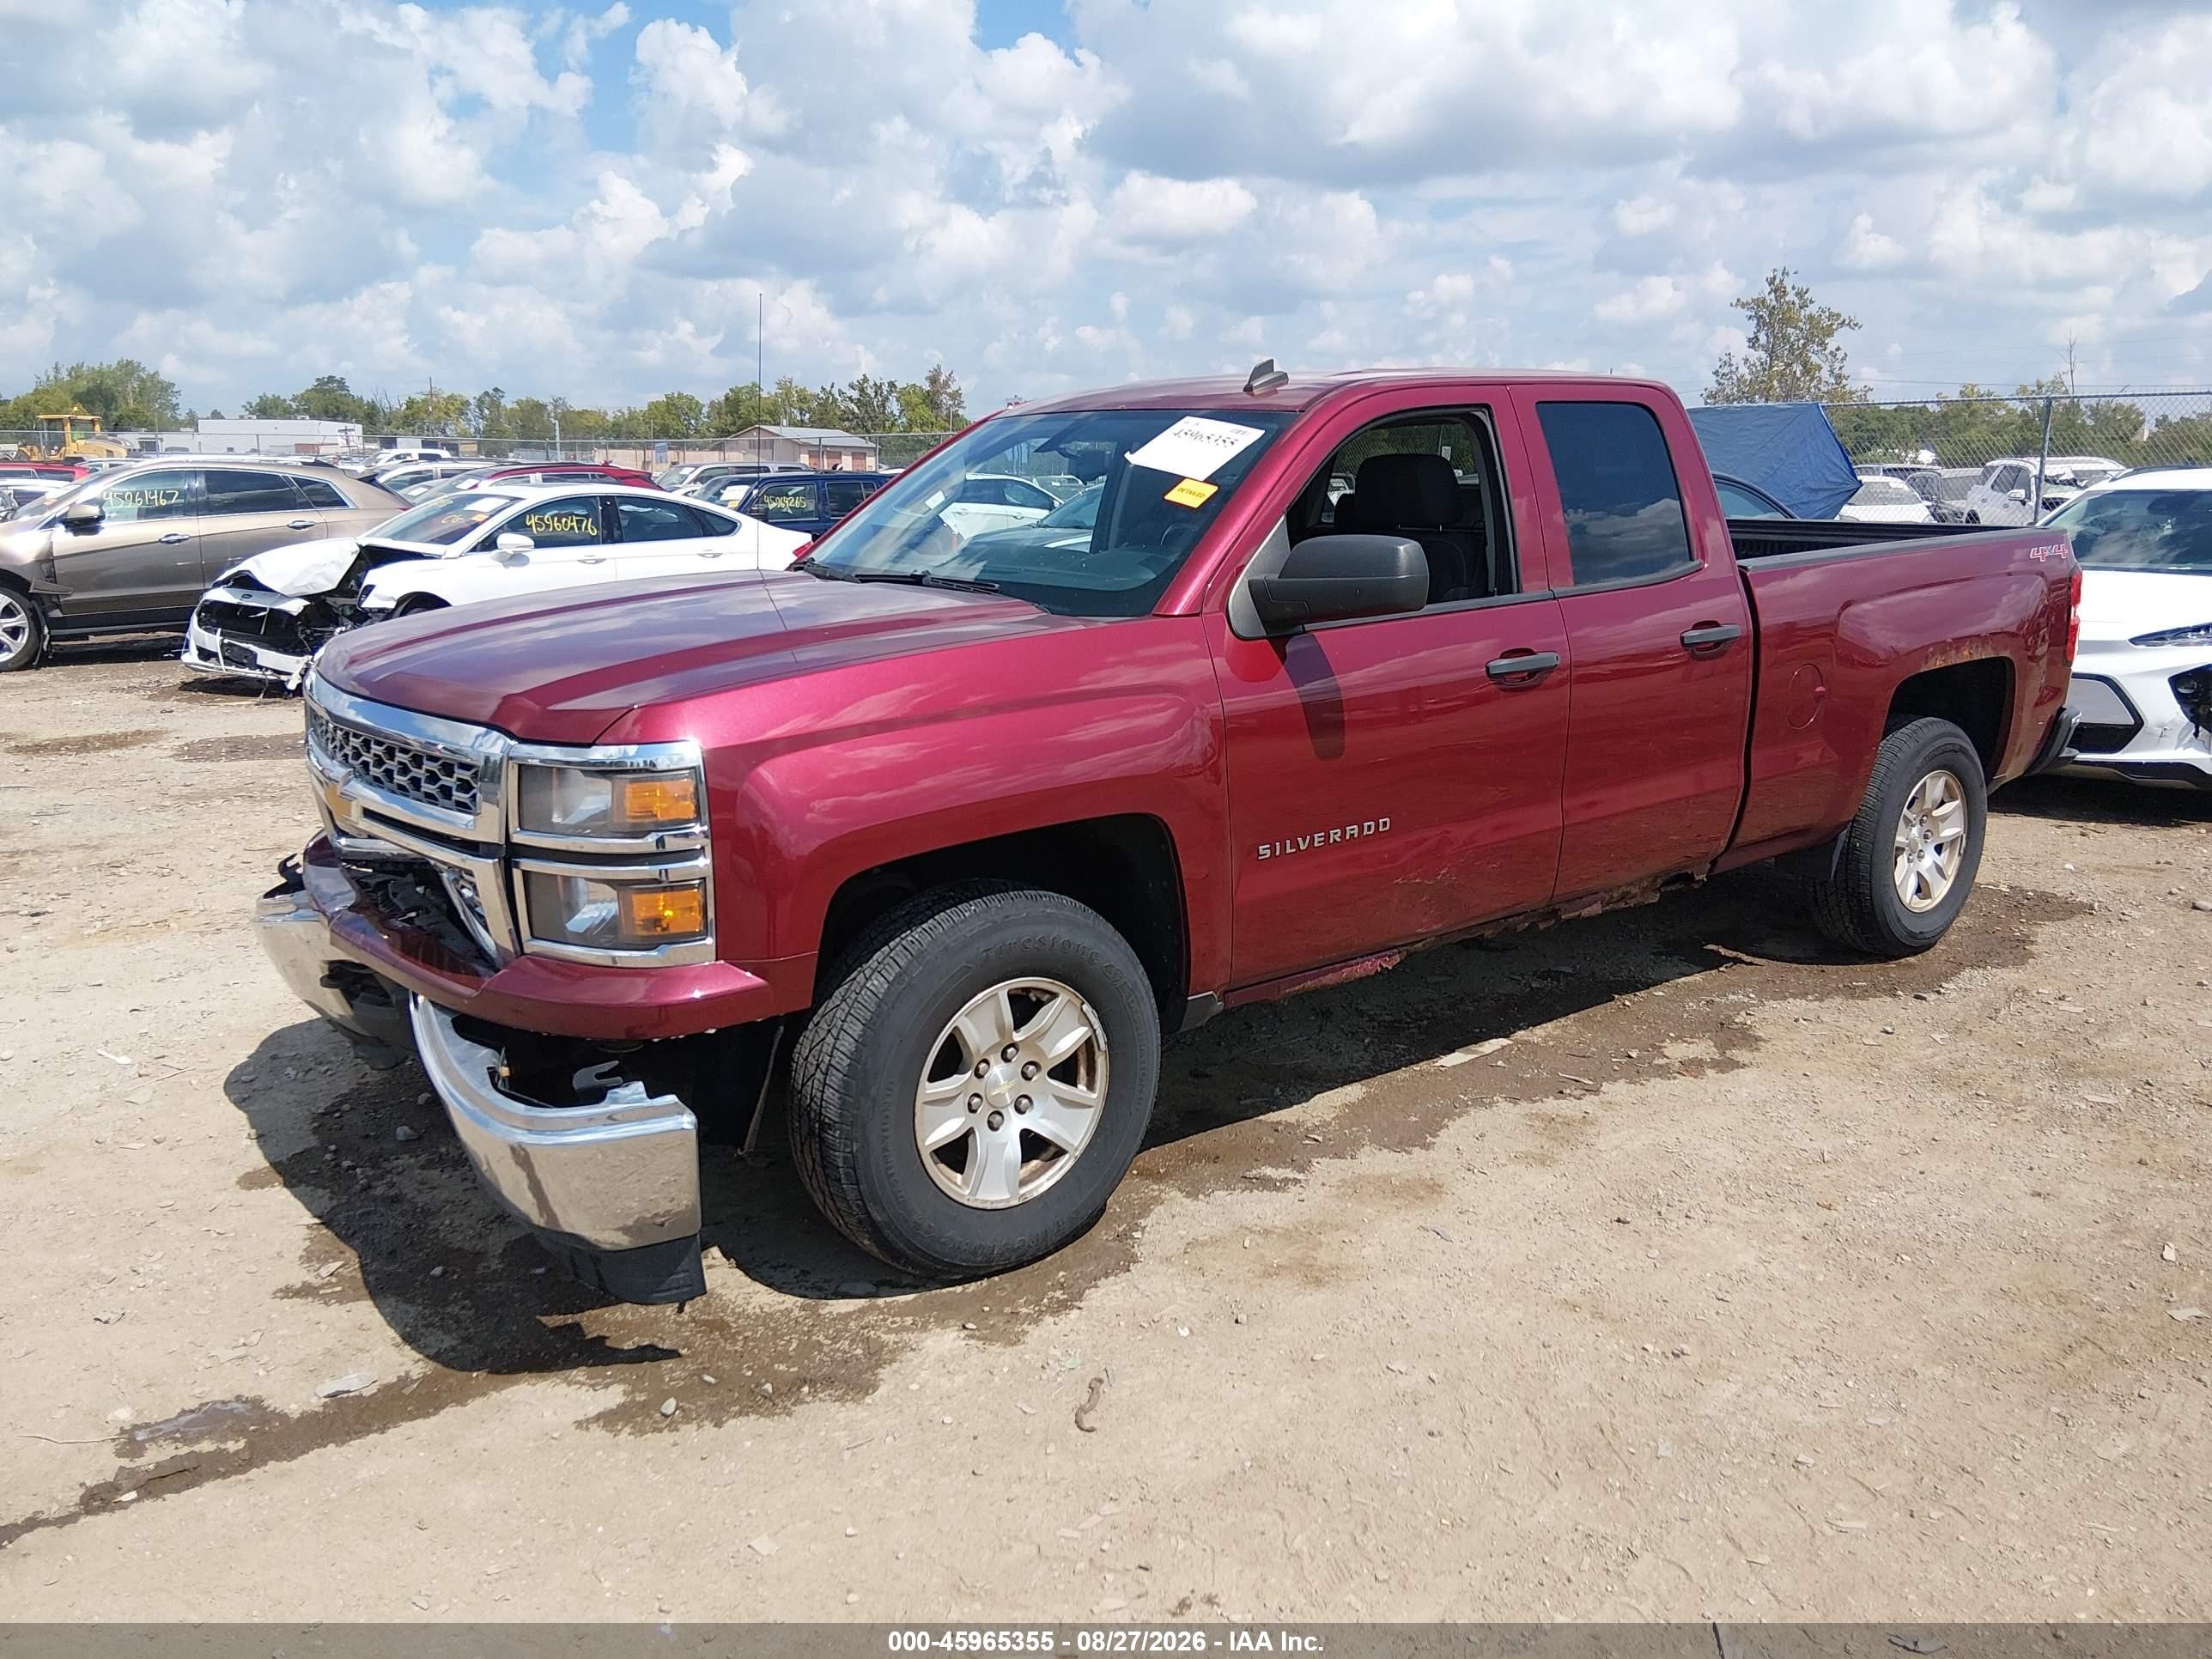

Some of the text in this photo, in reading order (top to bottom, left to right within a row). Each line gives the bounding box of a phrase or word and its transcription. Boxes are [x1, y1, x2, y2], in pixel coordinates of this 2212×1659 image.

[103, 489, 179, 507] 45961467
[526, 514, 598, 536] 45960476
[1257, 817, 1391, 860] SILVERADO
[981, 934, 1100, 965] Firestone
